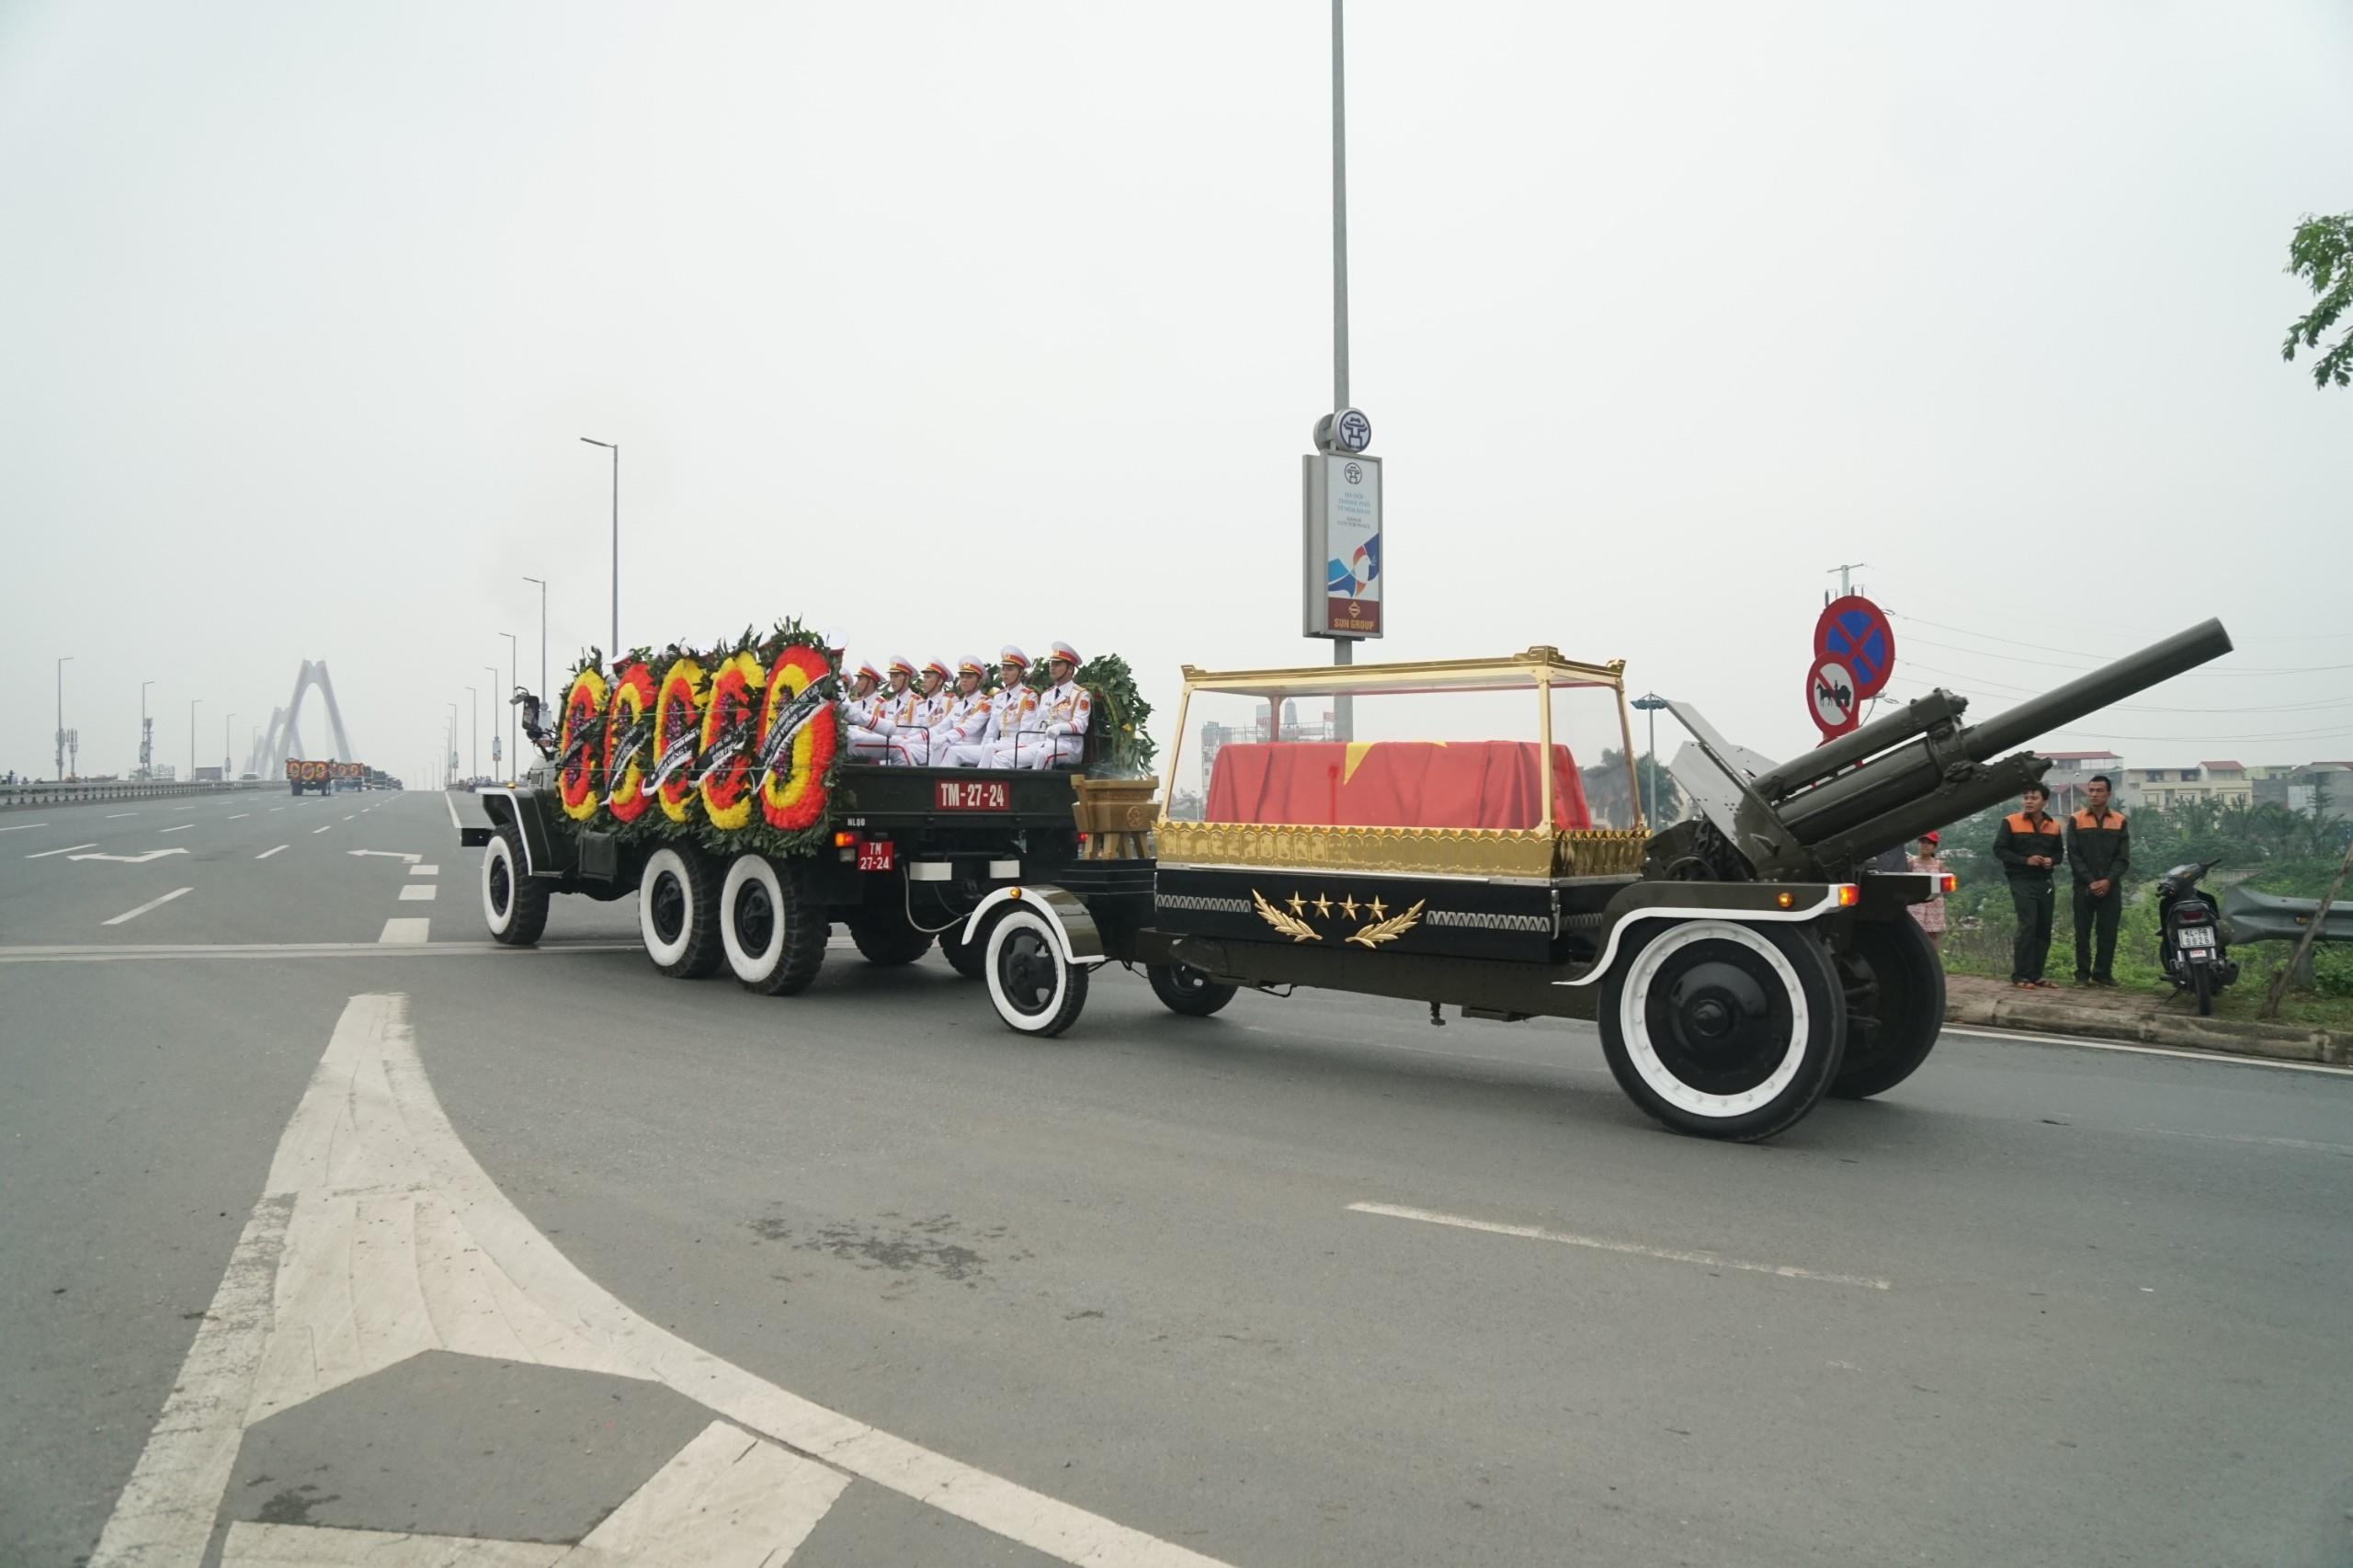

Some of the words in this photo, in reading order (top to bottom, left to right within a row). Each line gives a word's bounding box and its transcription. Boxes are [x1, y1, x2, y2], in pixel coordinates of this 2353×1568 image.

[1334, 618, 1349, 629] SUN
[1350, 619, 1374, 631] GROUP
[940, 782, 1005, 807] TM-27-24
[869, 842, 882, 855] TM
[860, 855, 890, 870] 27-24
